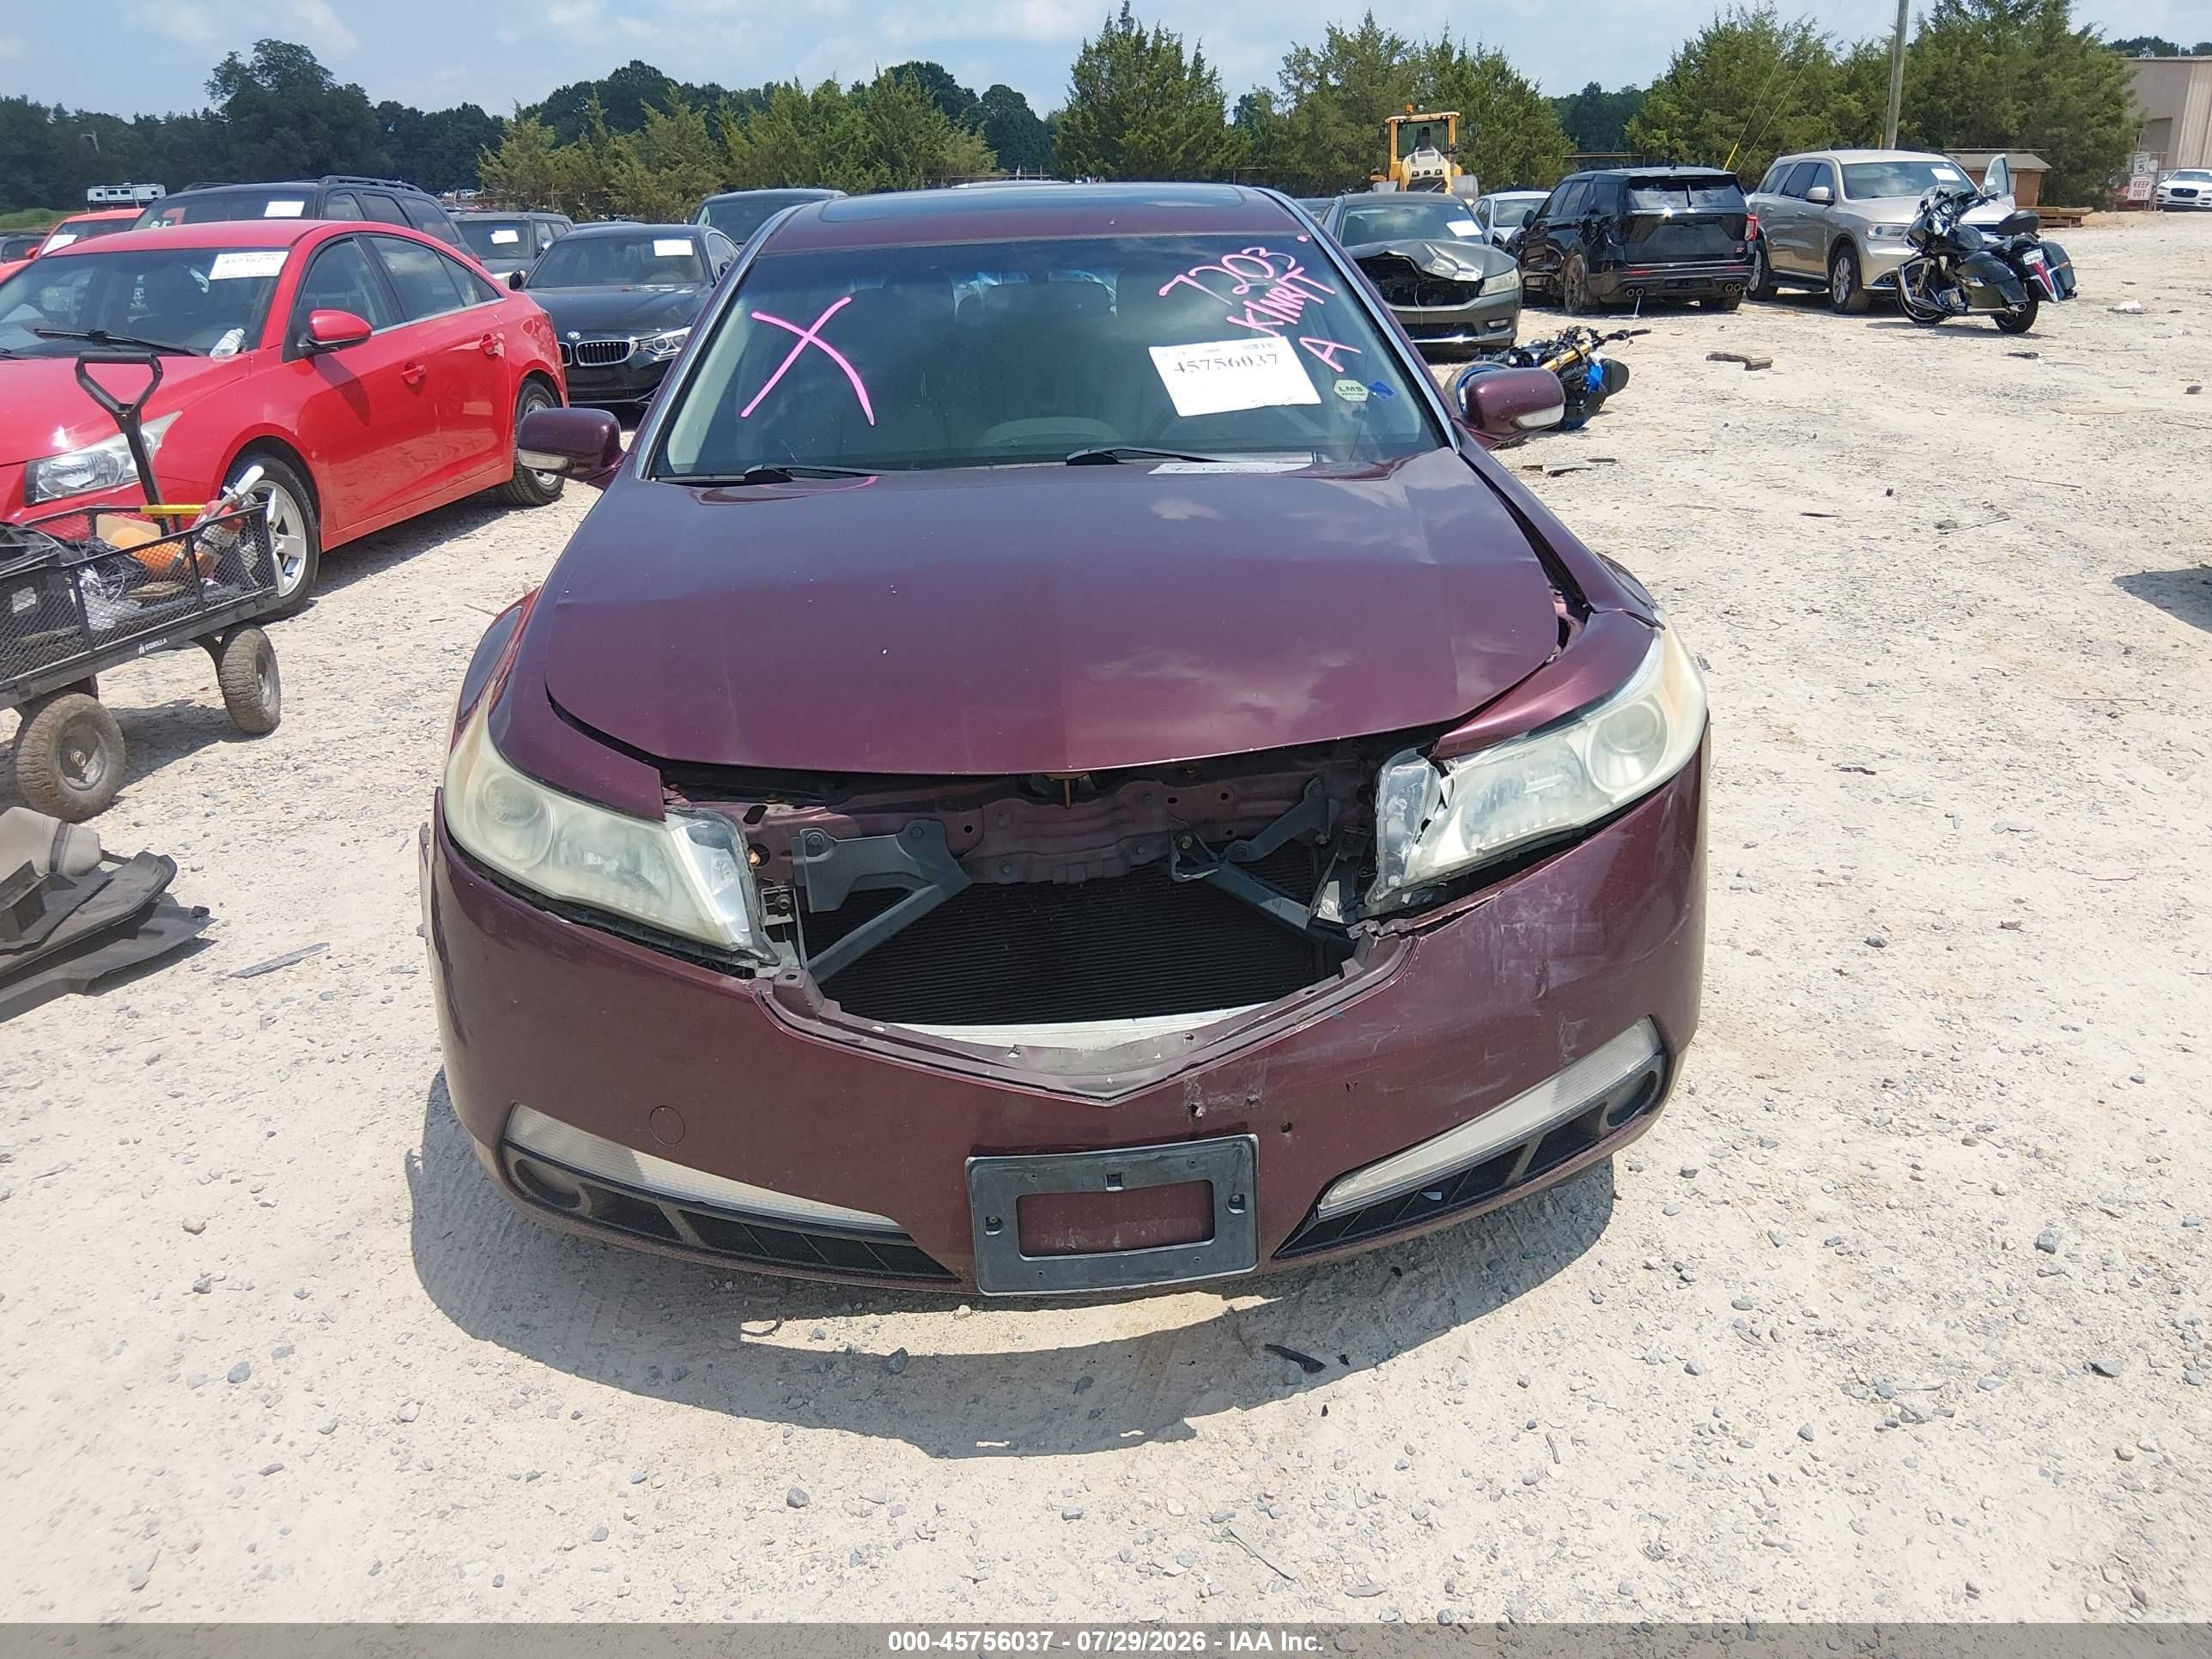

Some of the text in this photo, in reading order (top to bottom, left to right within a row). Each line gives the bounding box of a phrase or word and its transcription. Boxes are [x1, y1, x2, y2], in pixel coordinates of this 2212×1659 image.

[1158, 246, 1297, 307] 7203
[1174, 353, 1278, 374] 45756037
[1298, 336, 1363, 373] A
